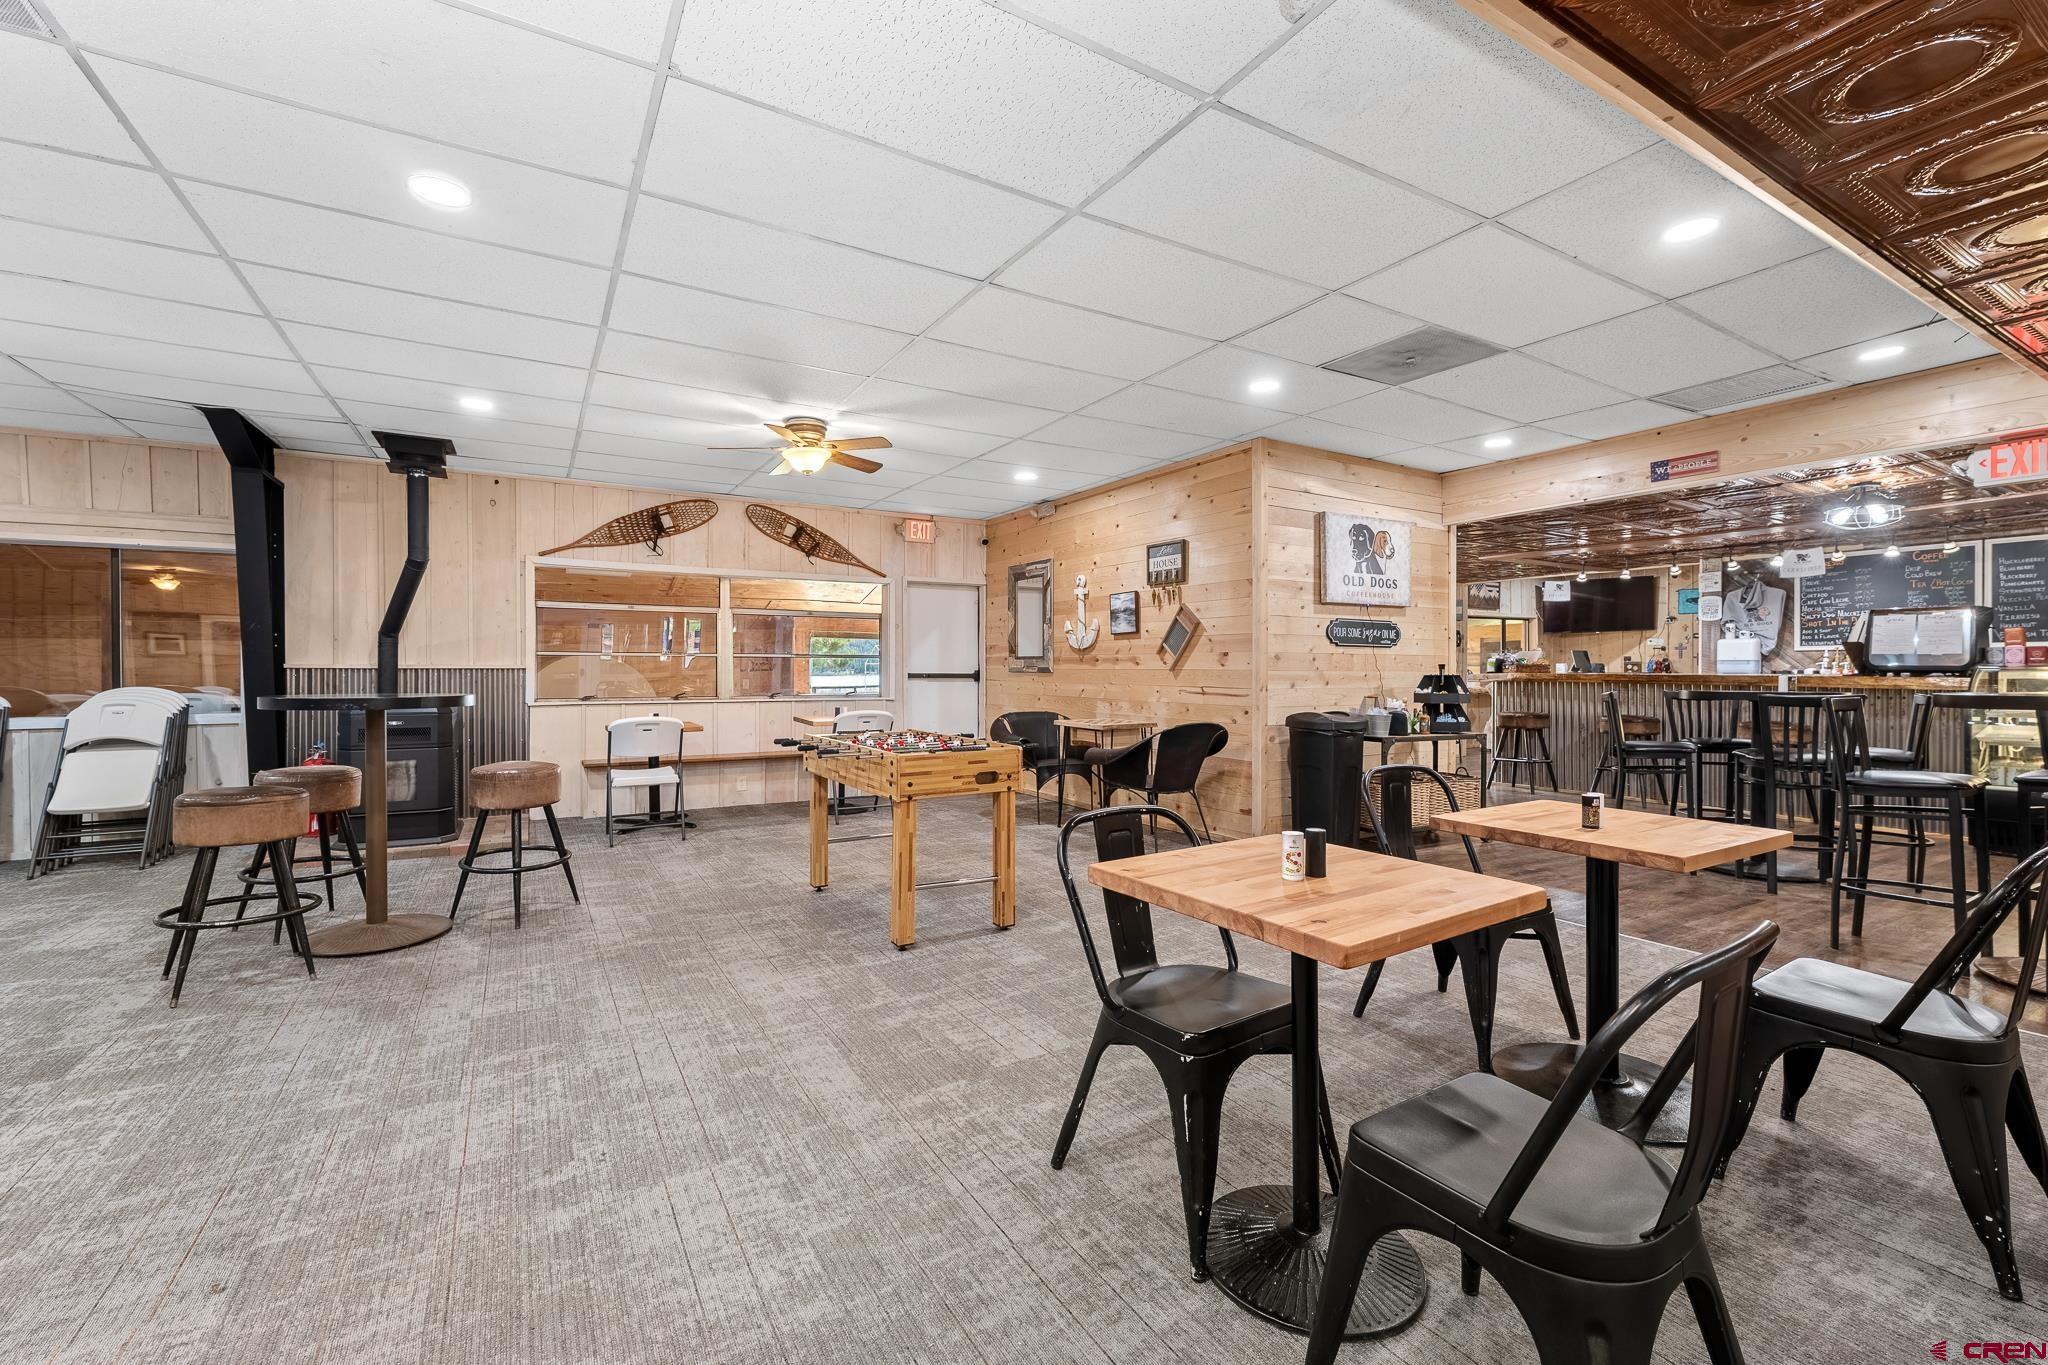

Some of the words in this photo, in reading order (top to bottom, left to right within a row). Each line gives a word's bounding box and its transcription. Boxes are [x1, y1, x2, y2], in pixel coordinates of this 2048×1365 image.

[1678, 459, 1712, 470] PEOPLE
[911, 521, 931, 539] EXIT
[1912, 551, 1949, 560] COFFEE
[1153, 557, 1178, 569] HOUSE
[1343, 575, 1365, 587] OLD
[1371, 577, 1398, 589] DOGS
[1333, 627, 1347, 637] POUR
[1347, 628, 1361, 638] SOME
[1381, 629, 1389, 639] ON
[1389, 630, 1396, 639] ME
